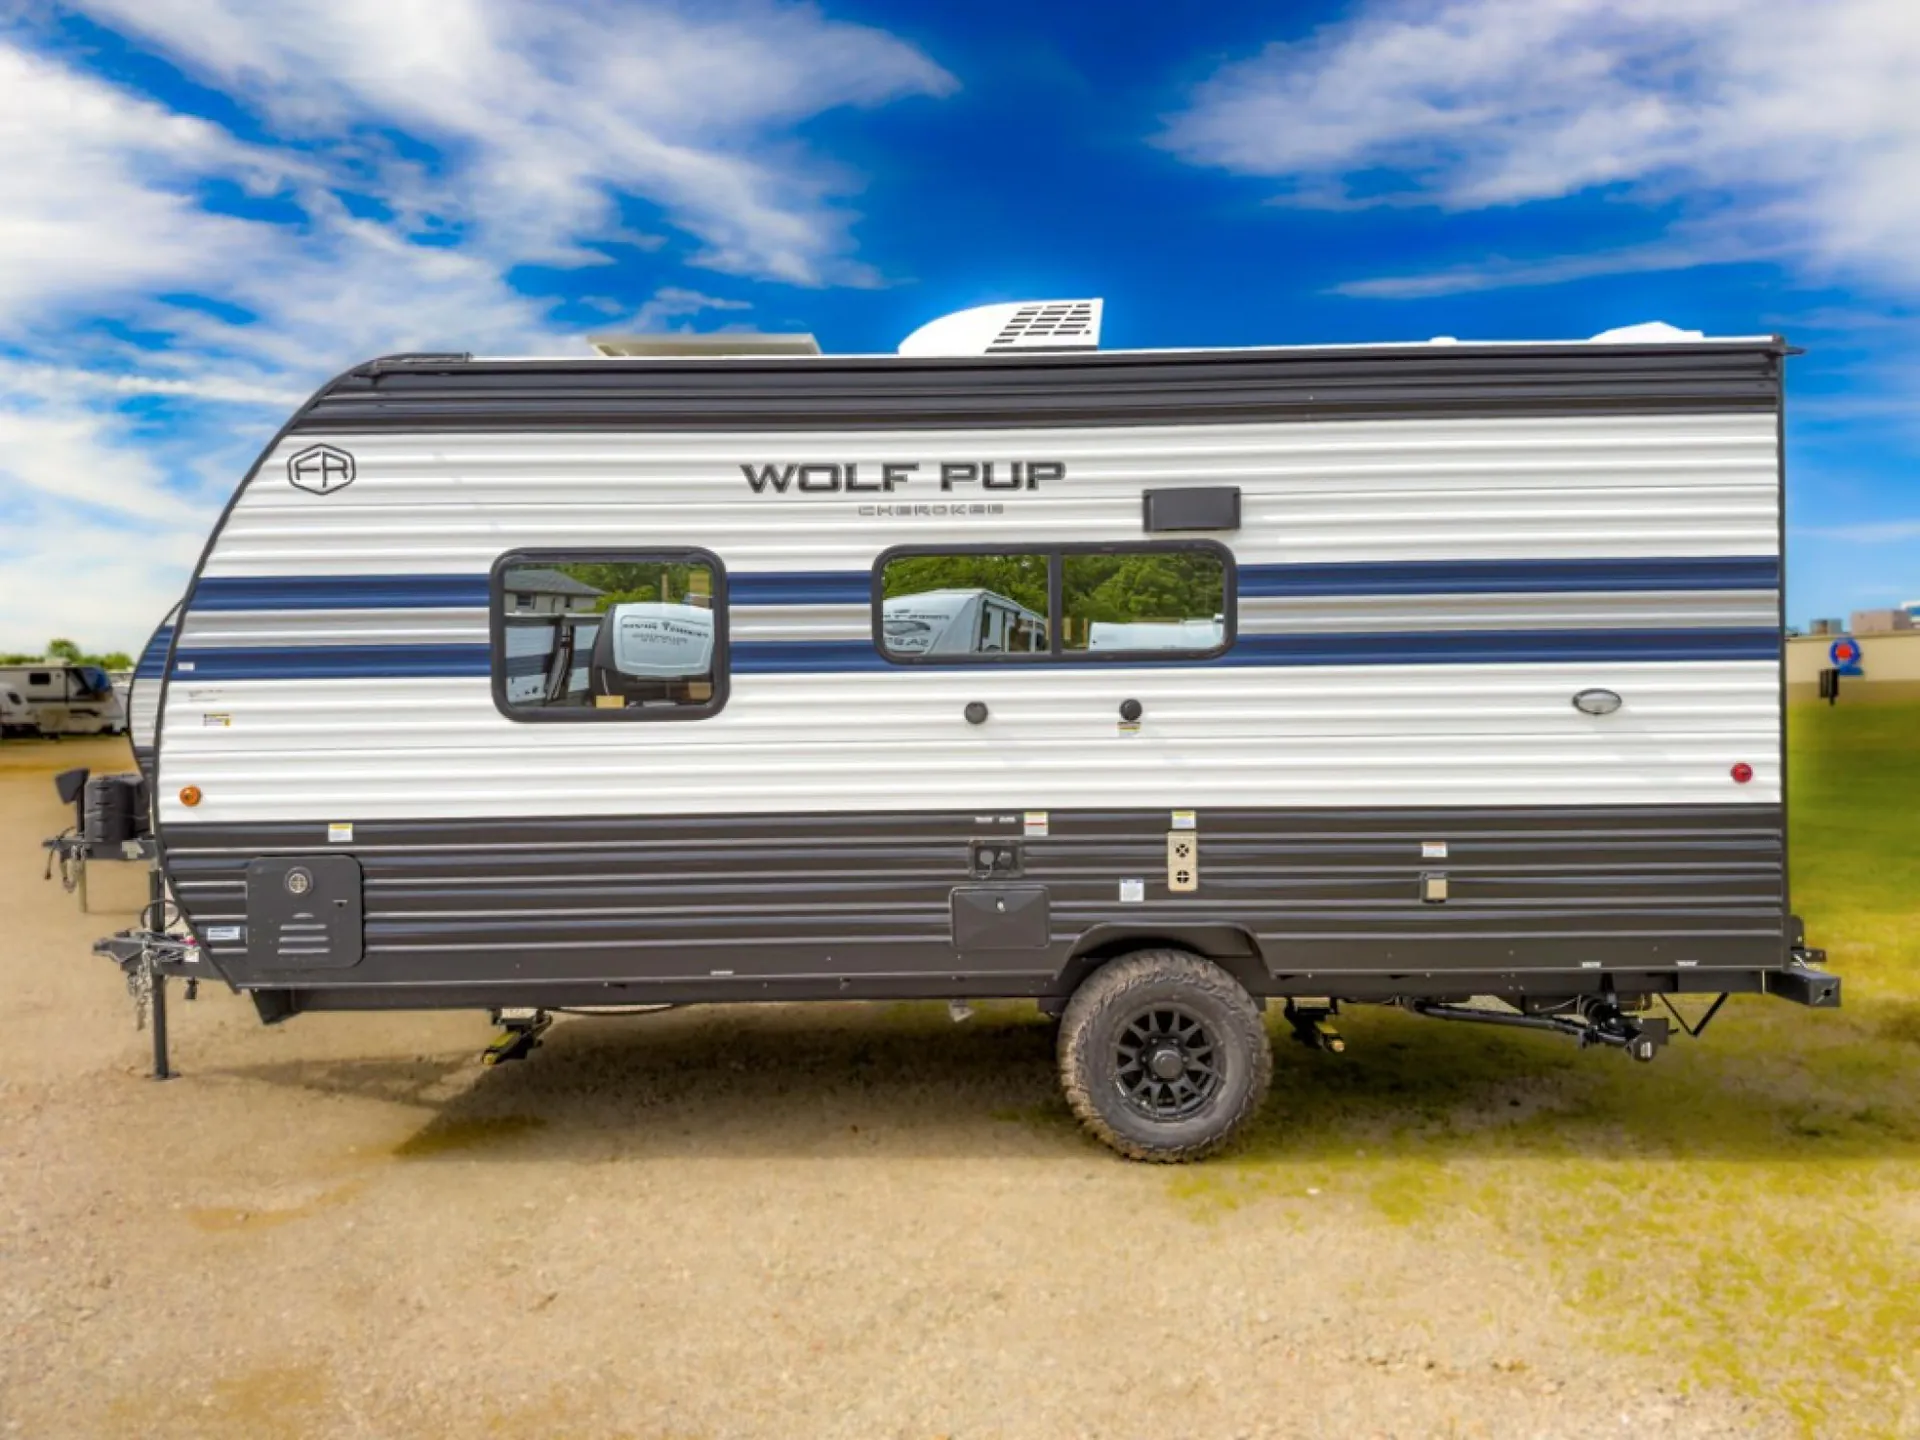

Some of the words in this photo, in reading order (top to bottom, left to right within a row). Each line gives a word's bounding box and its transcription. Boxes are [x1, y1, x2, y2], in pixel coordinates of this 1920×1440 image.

[740, 462, 920, 494] WOLF
[940, 461, 1066, 492] PUP
[858, 503, 1004, 517] CHEROKEE
